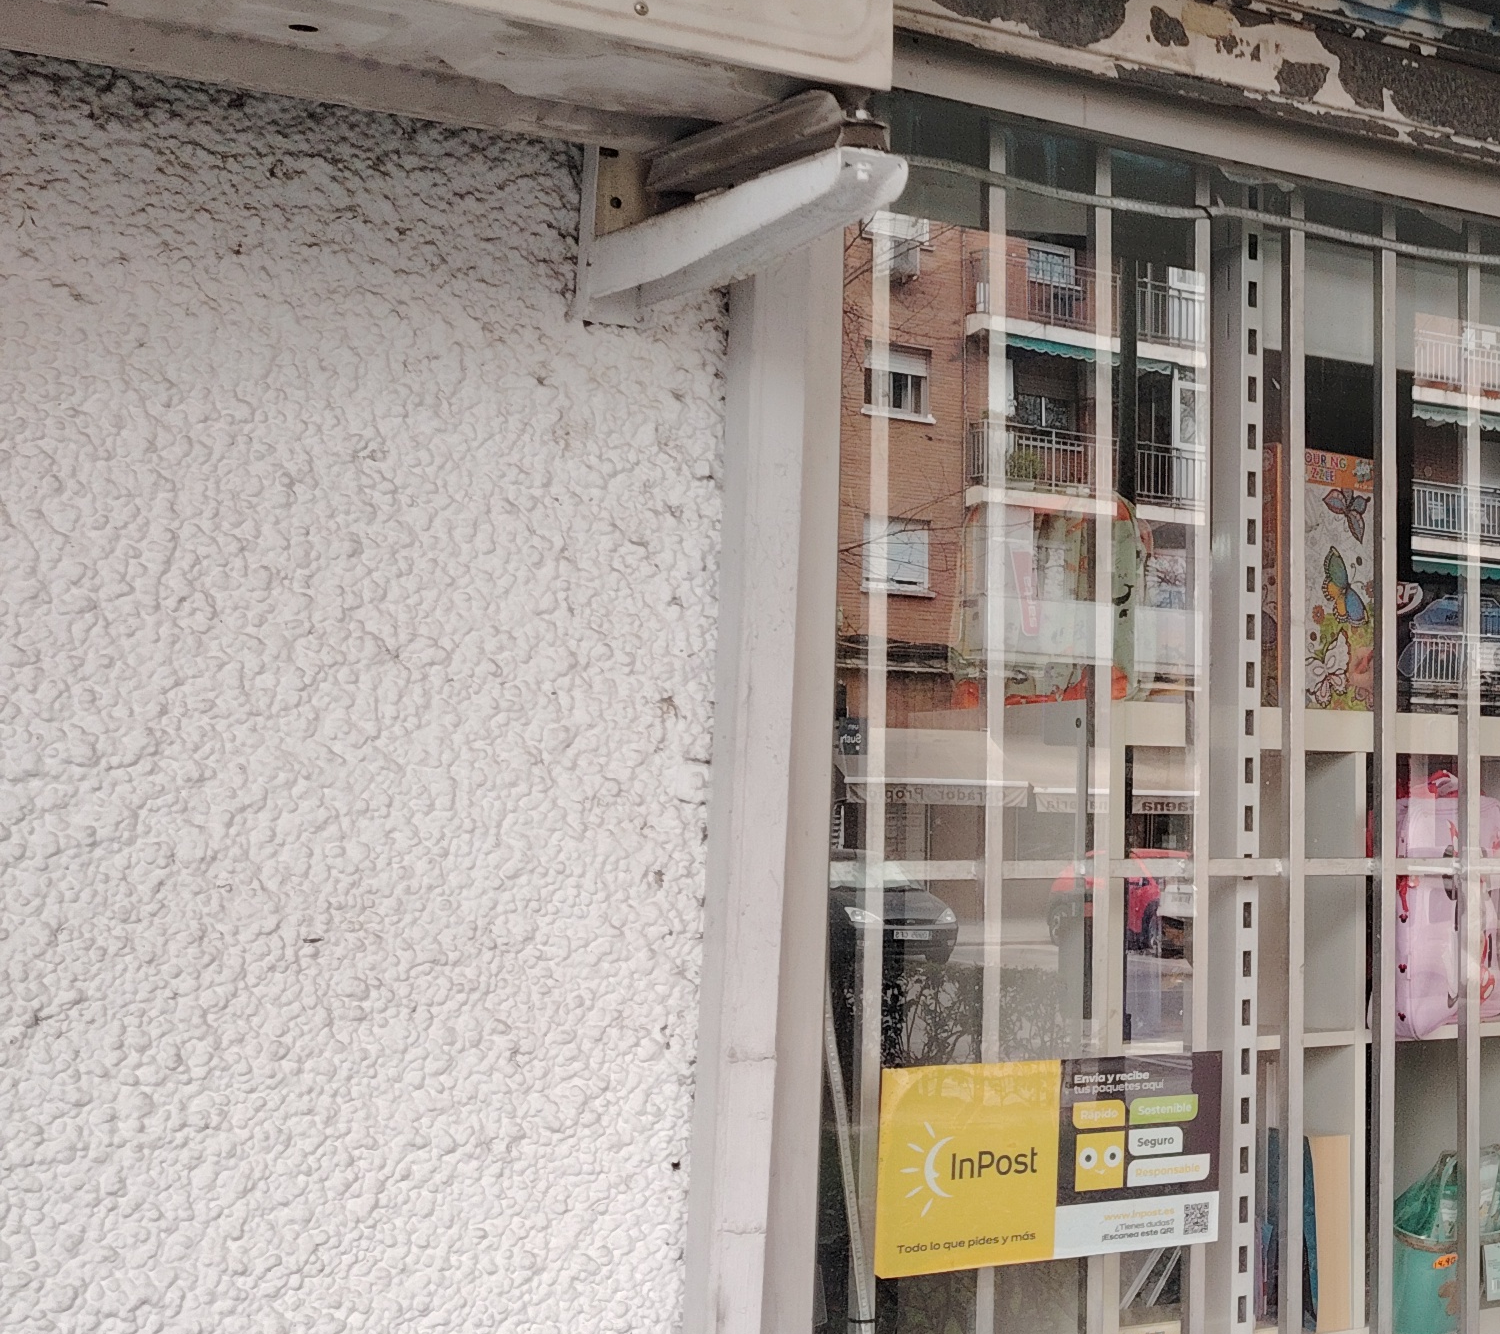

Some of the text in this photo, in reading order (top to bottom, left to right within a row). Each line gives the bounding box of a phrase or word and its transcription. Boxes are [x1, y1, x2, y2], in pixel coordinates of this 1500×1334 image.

[1396, 582, 1419, 604] RF
[1074, 1070, 1150, 1085] Envía y recibe
[1074, 1078, 1164, 1094] tus paquetes aquí
[1080, 1107, 1118, 1122] Rápido
[1138, 1102, 1192, 1116] Sostenible
[1137, 1135, 1175, 1149] Seguro
[950, 1147, 1038, 1180] InPost
[1135, 1162, 1200, 1178] Responsable
[1104, 1207, 1175, 1221] www.inpost.es
[1114, 1221, 1145, 1233] ¿Tienes
[1140, 1228, 1159, 1238] este
[897, 1229, 1036, 1255] Todo lo que pides y más
